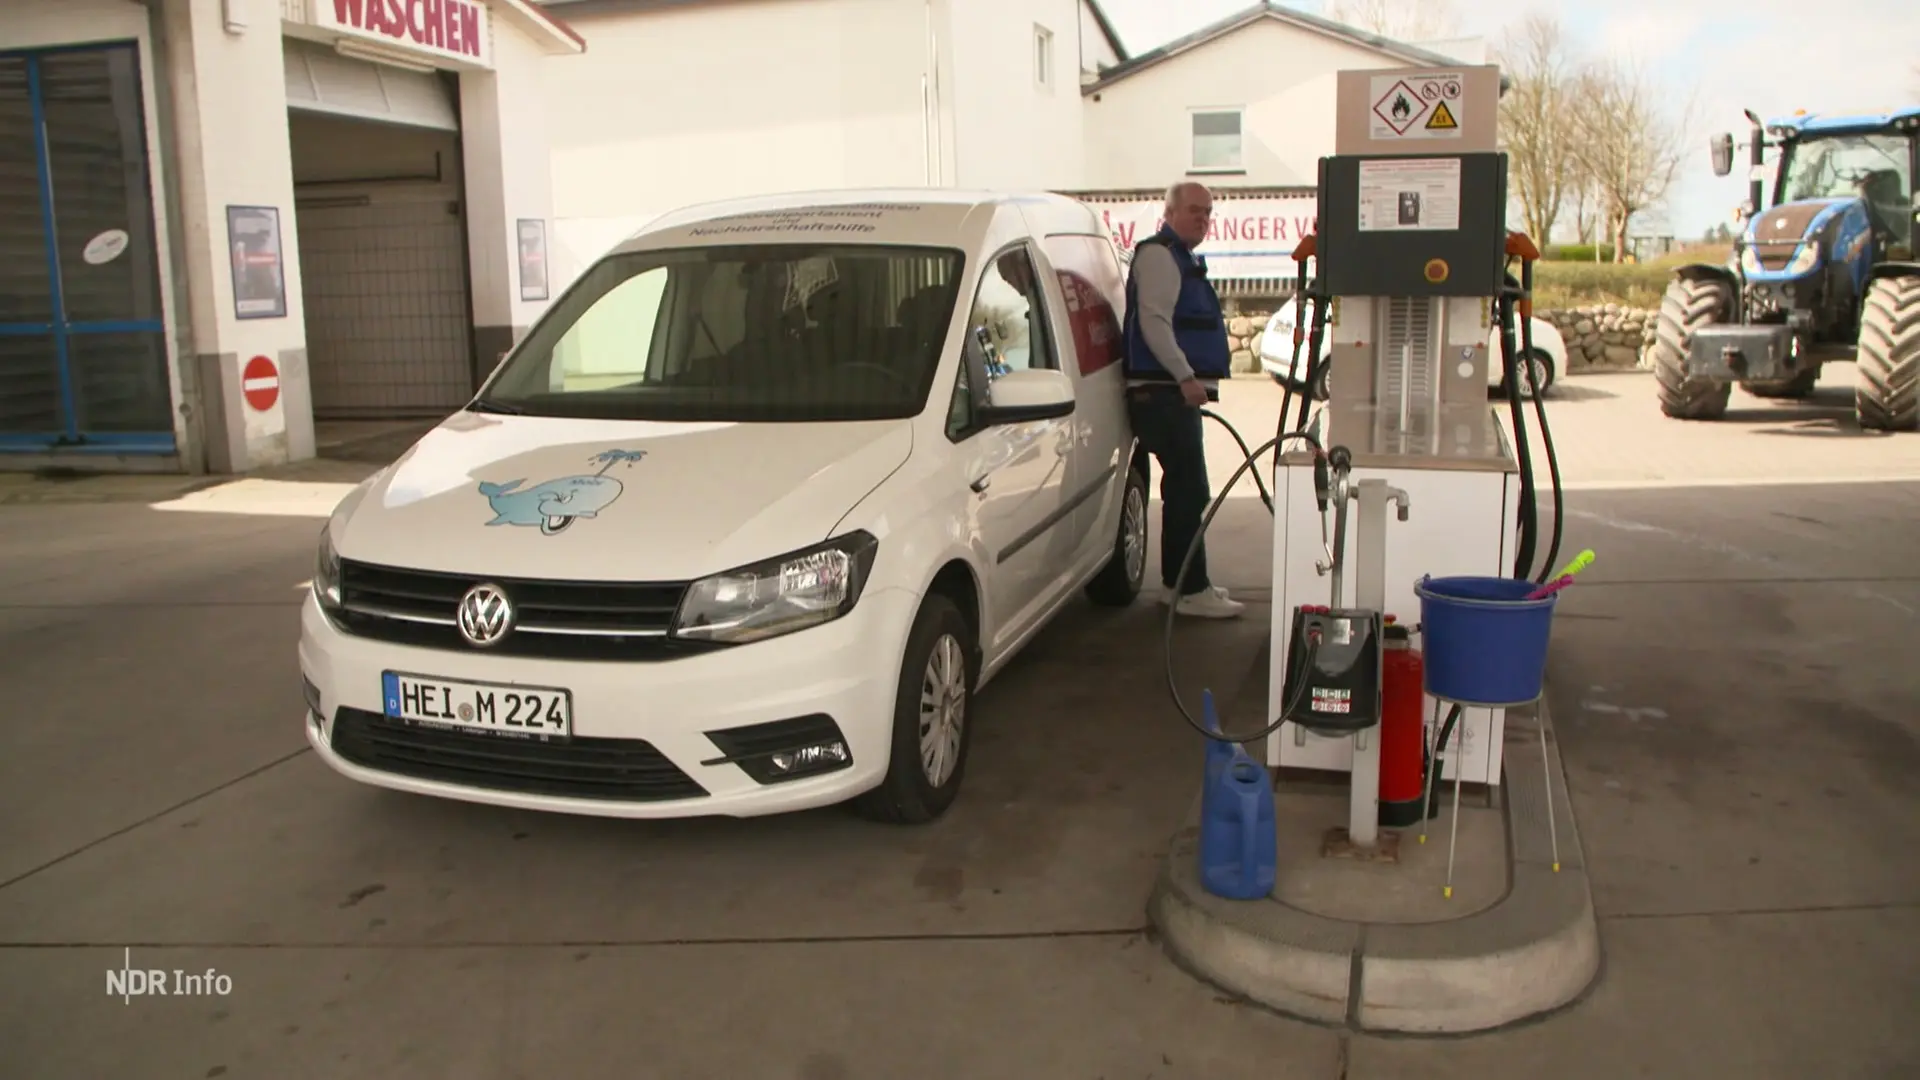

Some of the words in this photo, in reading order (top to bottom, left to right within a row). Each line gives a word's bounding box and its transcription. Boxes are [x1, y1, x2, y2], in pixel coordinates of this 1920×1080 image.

[688, 221, 876, 237] Nachbarschaftshilfe
[402, 681, 456, 719] HEI
[475, 690, 496, 724] M
[504, 692, 564, 729] 224
